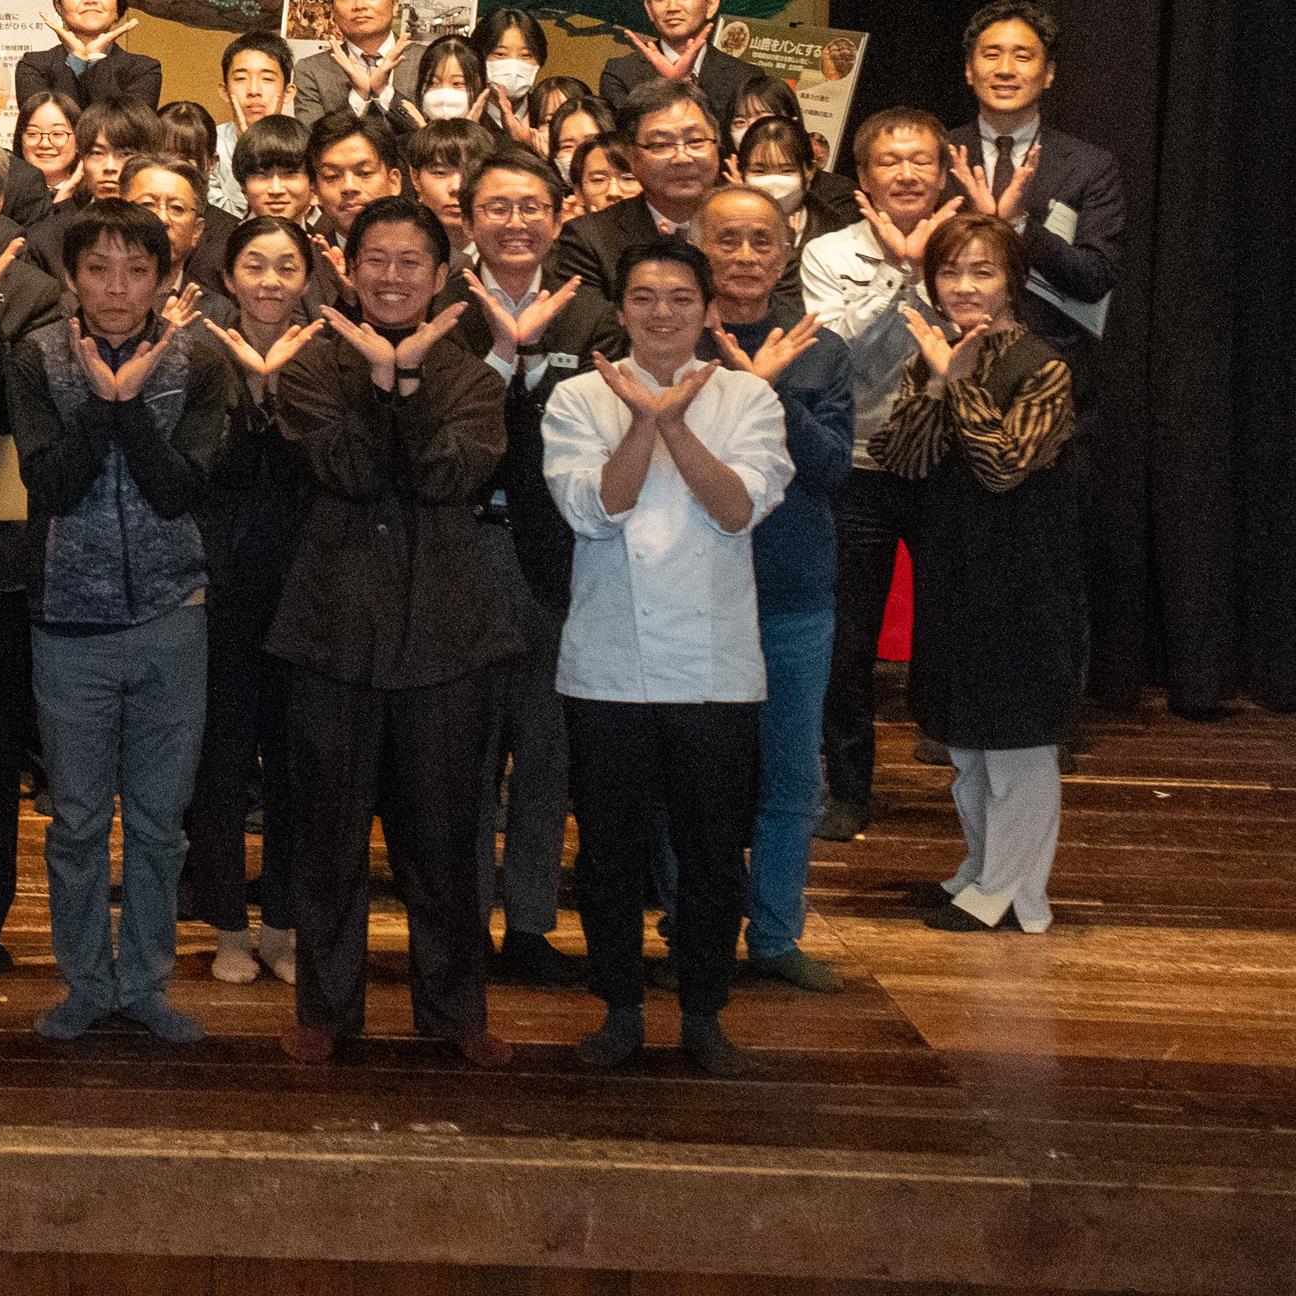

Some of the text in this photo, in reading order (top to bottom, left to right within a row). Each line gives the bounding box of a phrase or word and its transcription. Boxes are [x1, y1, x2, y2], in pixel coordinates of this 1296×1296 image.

[749, 37, 822, 58] 山鹿をパンにする
